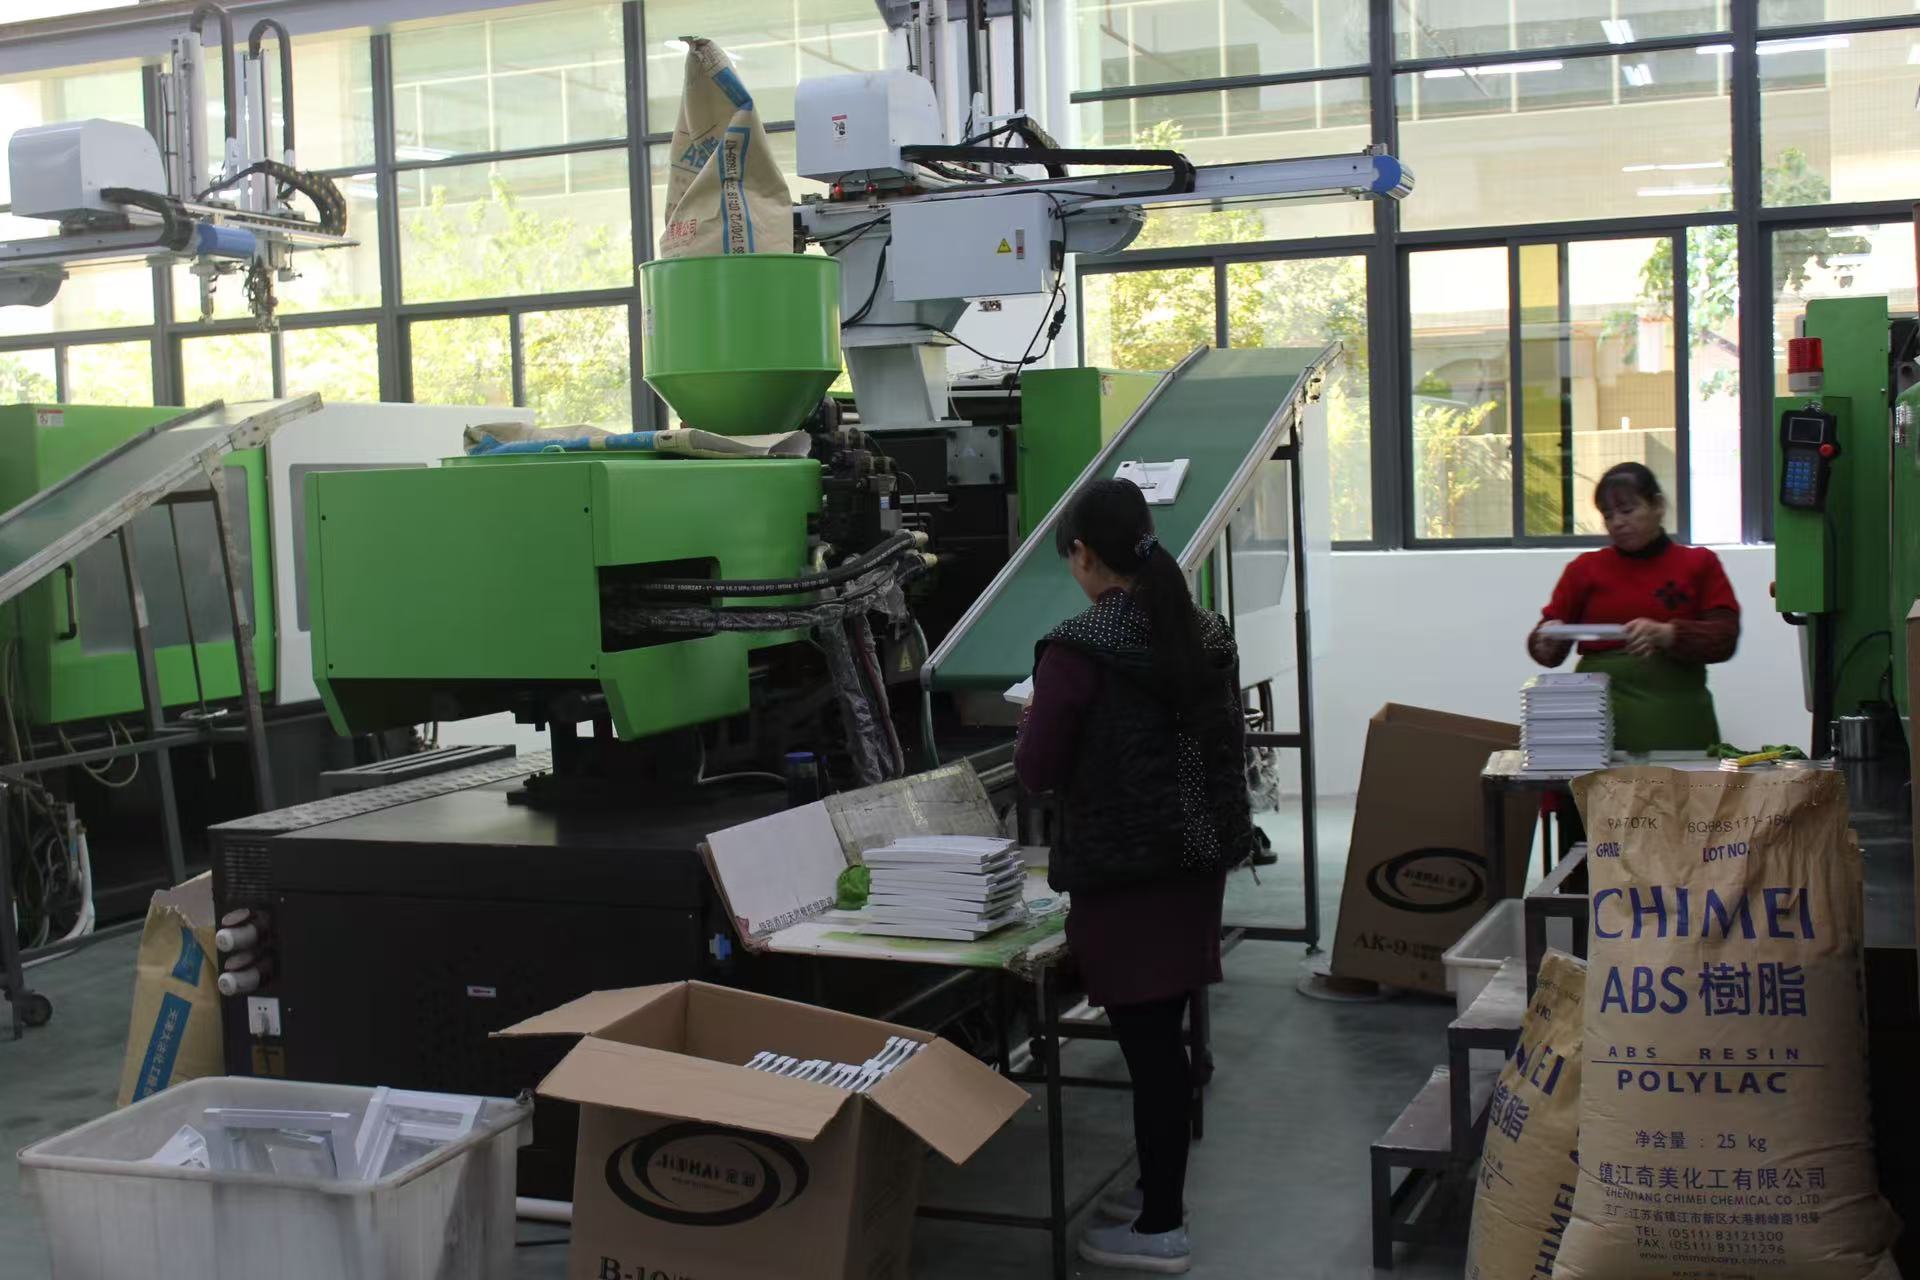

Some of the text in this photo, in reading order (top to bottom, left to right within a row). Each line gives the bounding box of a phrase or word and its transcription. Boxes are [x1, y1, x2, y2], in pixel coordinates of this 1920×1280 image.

[1703, 844, 1725, 863] LOT
[1593, 885, 1815, 940] CHIMEI
[1600, 966, 1688, 1015] ABS
[1698, 961, 1807, 1017] 樹脂
[1617, 1069, 1788, 1094] POLYLAC
[1717, 1133, 1736, 1149] 25
[1748, 1134, 1767, 1152] kg
[1599, 1160, 1826, 1190] 镇江奇美化工有限公司
[1605, 1186, 1661, 1204] ZHENJIANG
[1664, 1192, 1709, 1205] CHIMEI
[1711, 1193, 1770, 1206] CHEMICAL
